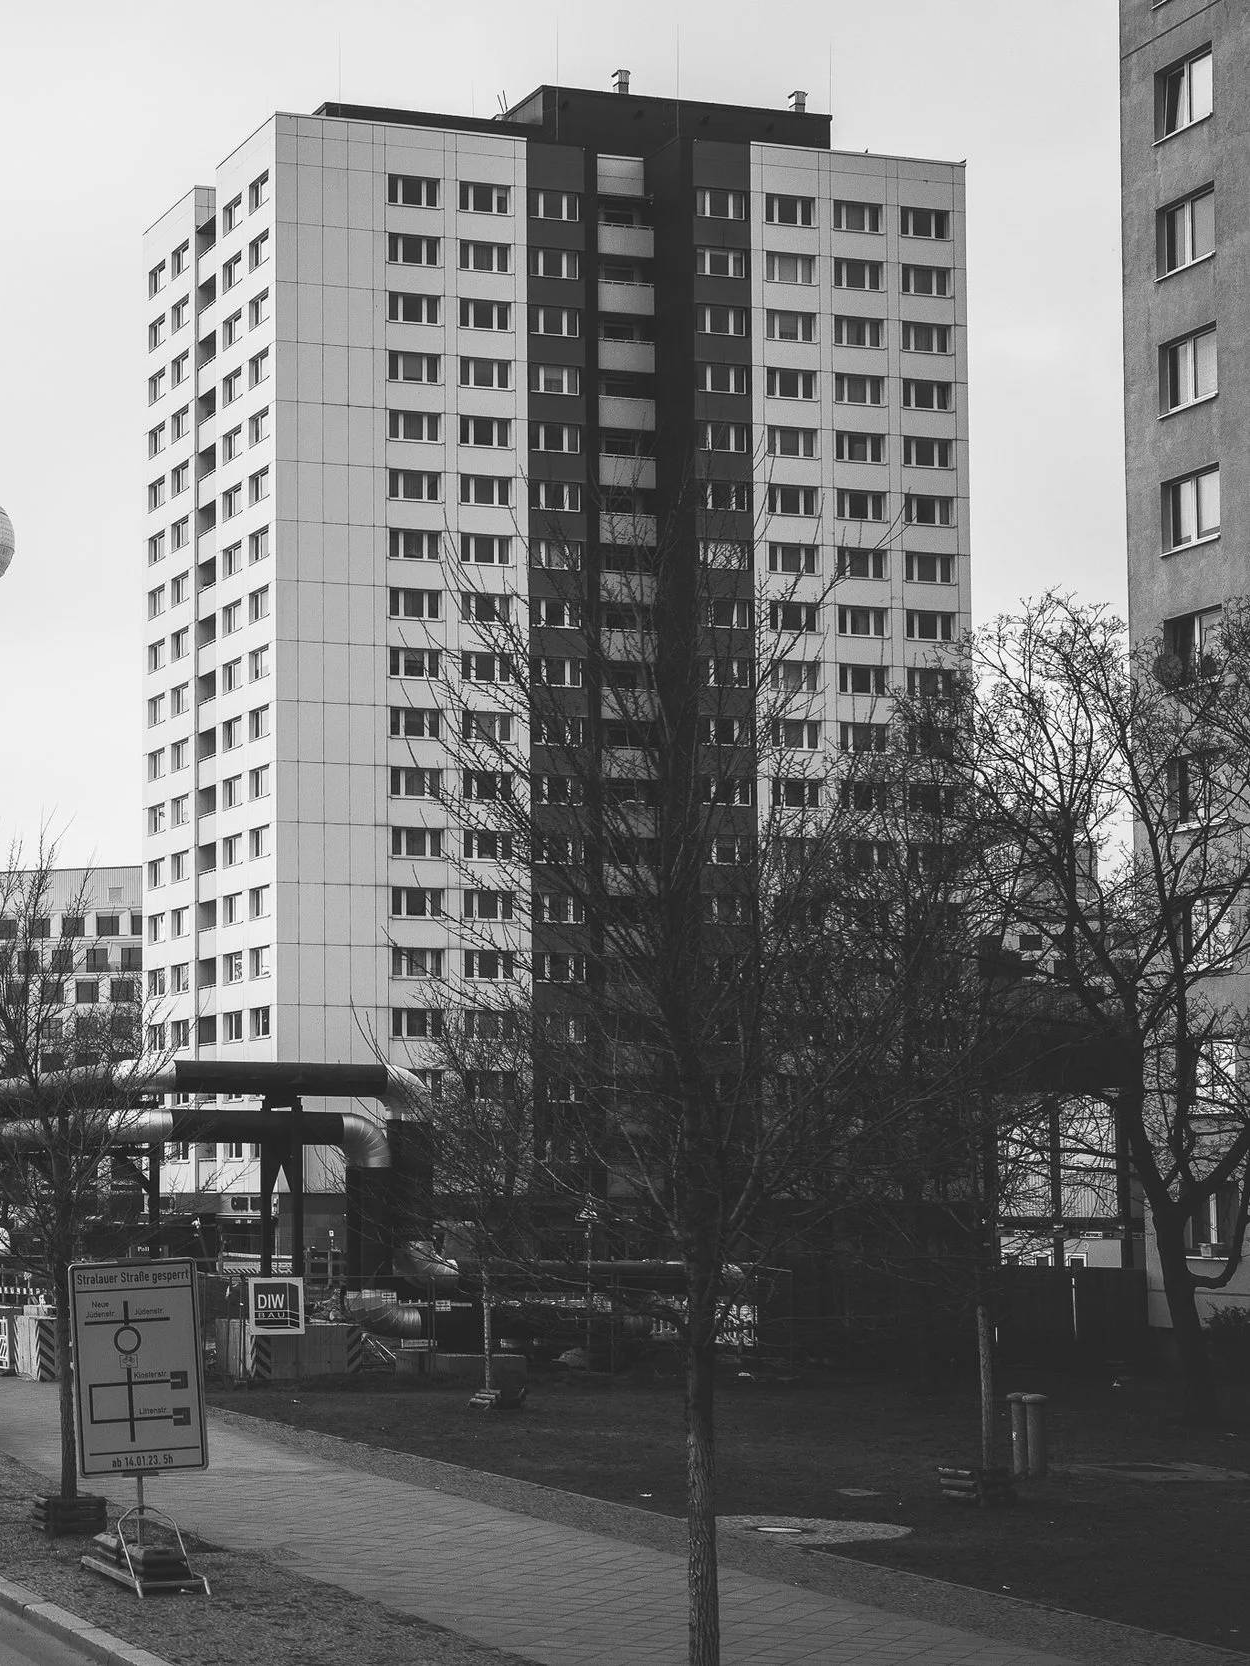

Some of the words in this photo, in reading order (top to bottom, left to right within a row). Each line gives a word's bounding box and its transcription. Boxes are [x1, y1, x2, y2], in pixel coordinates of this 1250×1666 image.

[77, 1274, 118, 1285] Stralauer
[120, 1271, 149, 1283] Straße
[152, 1269, 189, 1284] gesperrt
[258, 1294, 285, 1309] DIW
[85, 1310, 117, 1319] Jüdenstr.
[134, 1307, 165, 1316] Jüdenstr.
[133, 1370, 169, 1379] Klosterstr.
[138, 1407, 168, 1415] Littenstr.
[112, 1458, 122, 1468] ab
[163, 1454, 174, 1465] 5h
